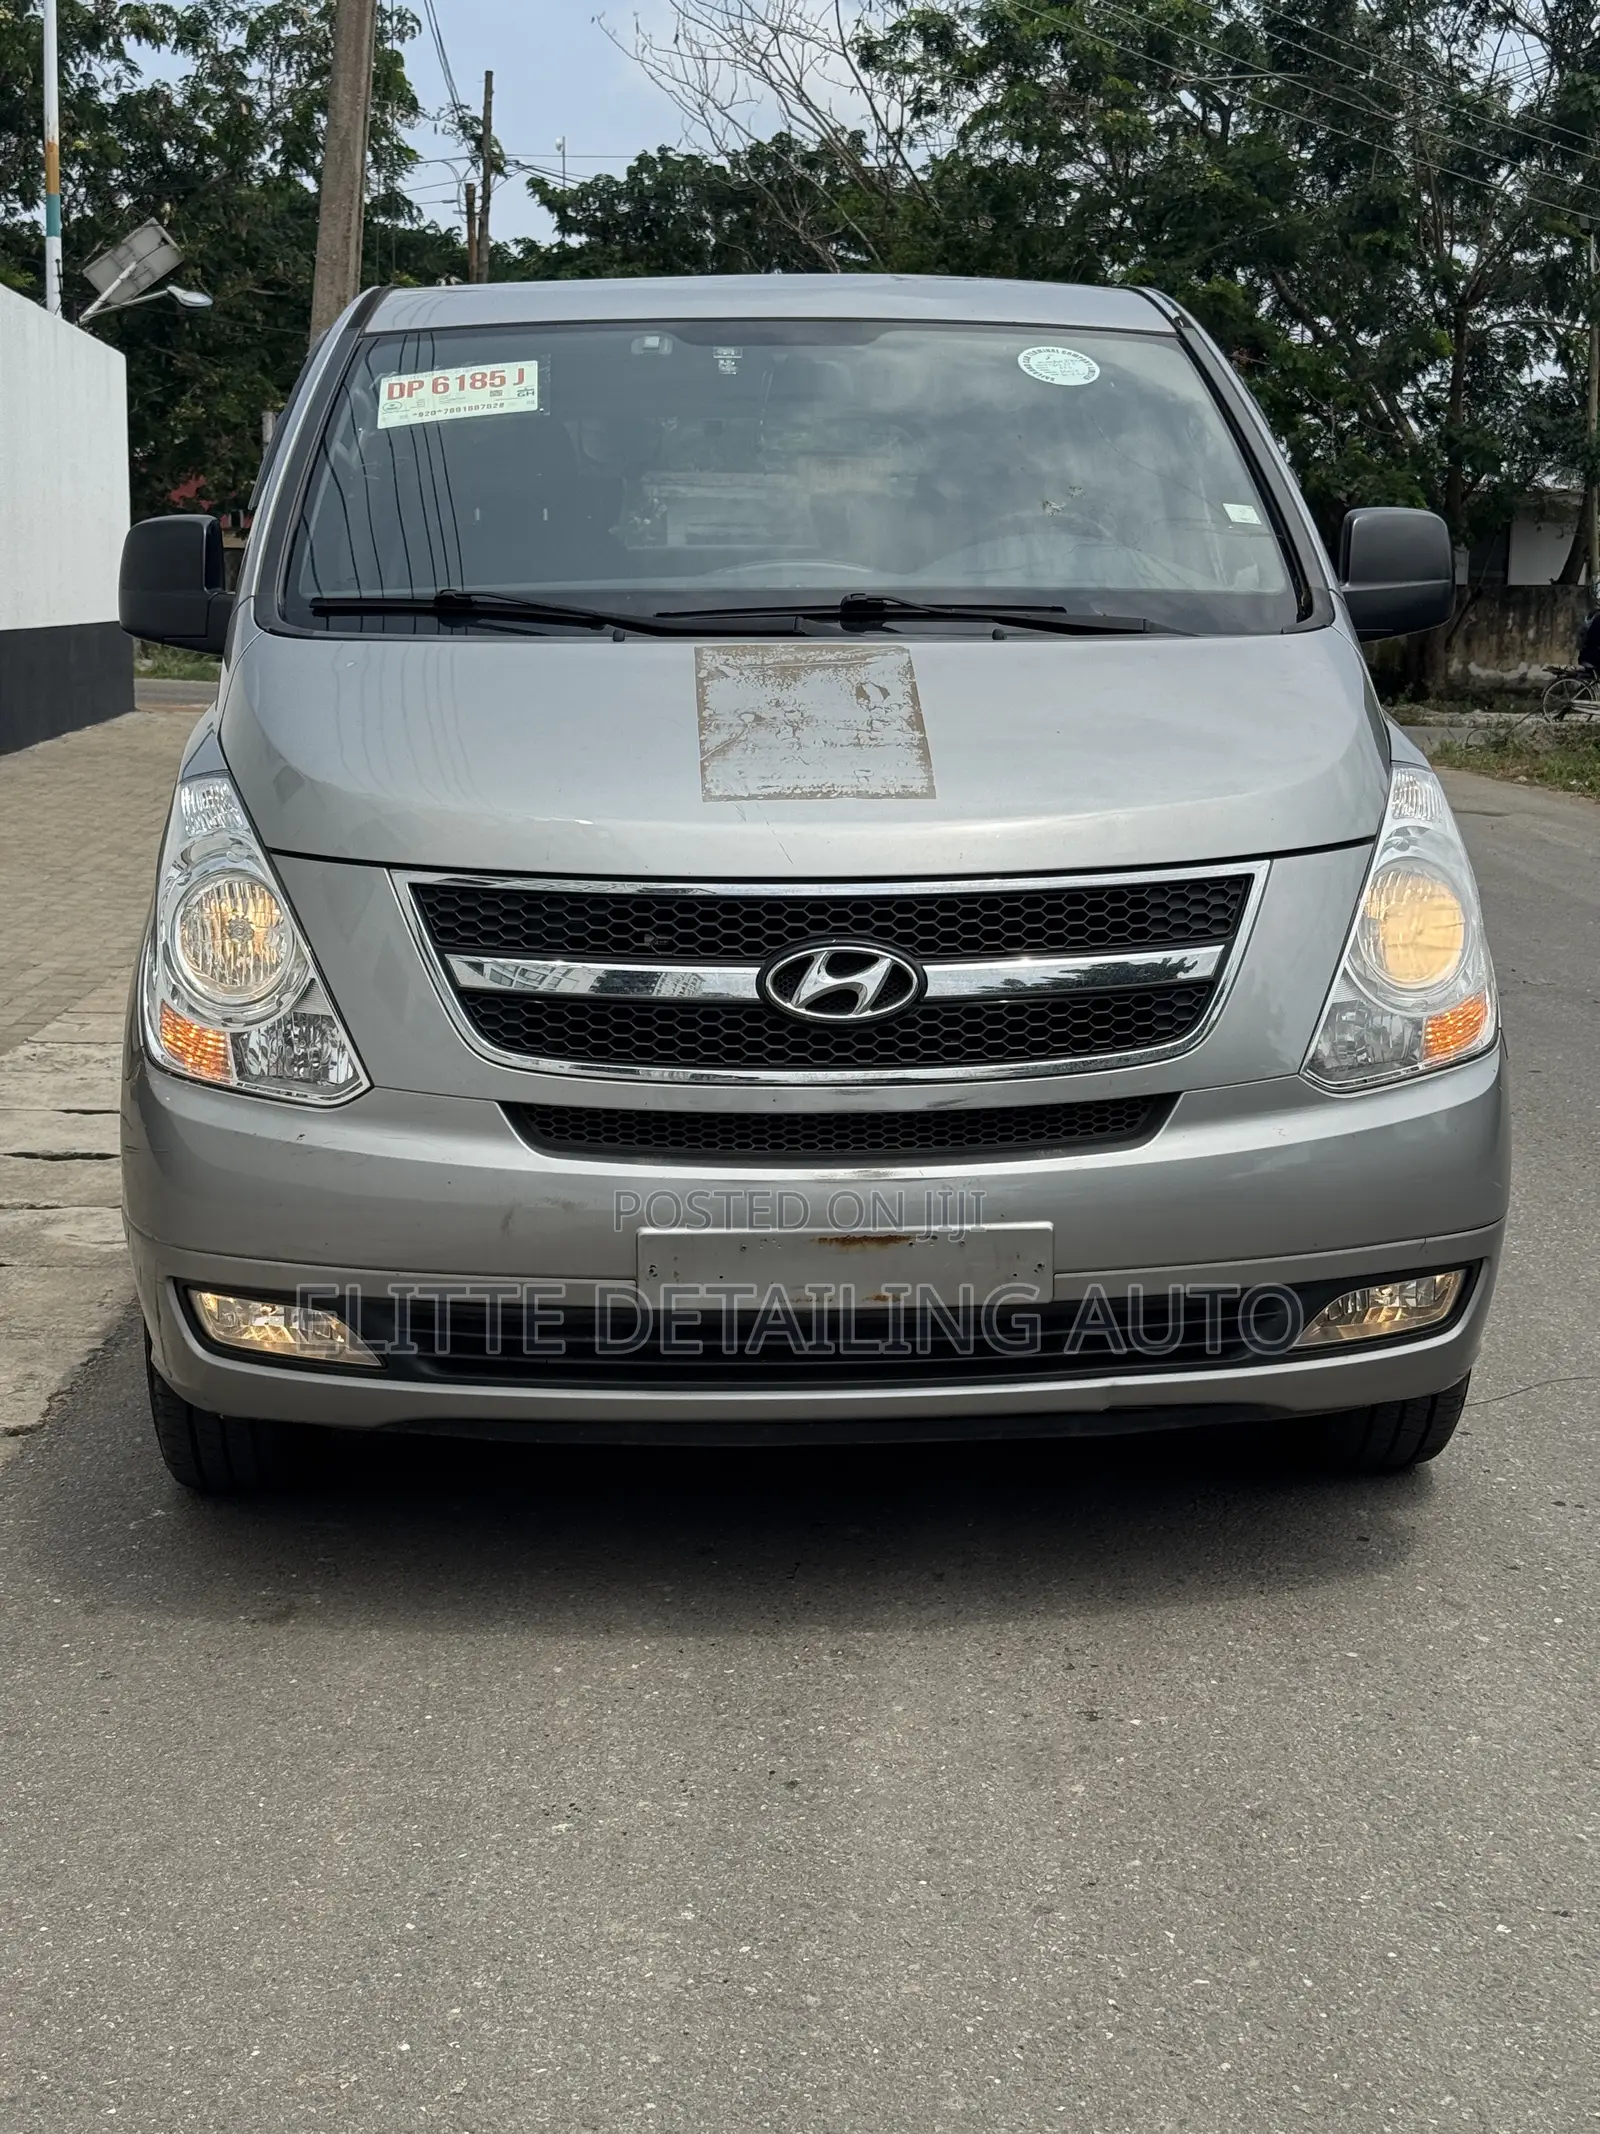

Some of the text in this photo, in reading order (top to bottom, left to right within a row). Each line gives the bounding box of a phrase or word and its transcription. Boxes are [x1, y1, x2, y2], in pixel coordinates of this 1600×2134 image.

[387, 379, 425, 401] DP
[431, 370, 507, 395] 6185
[513, 368, 525, 386] J
